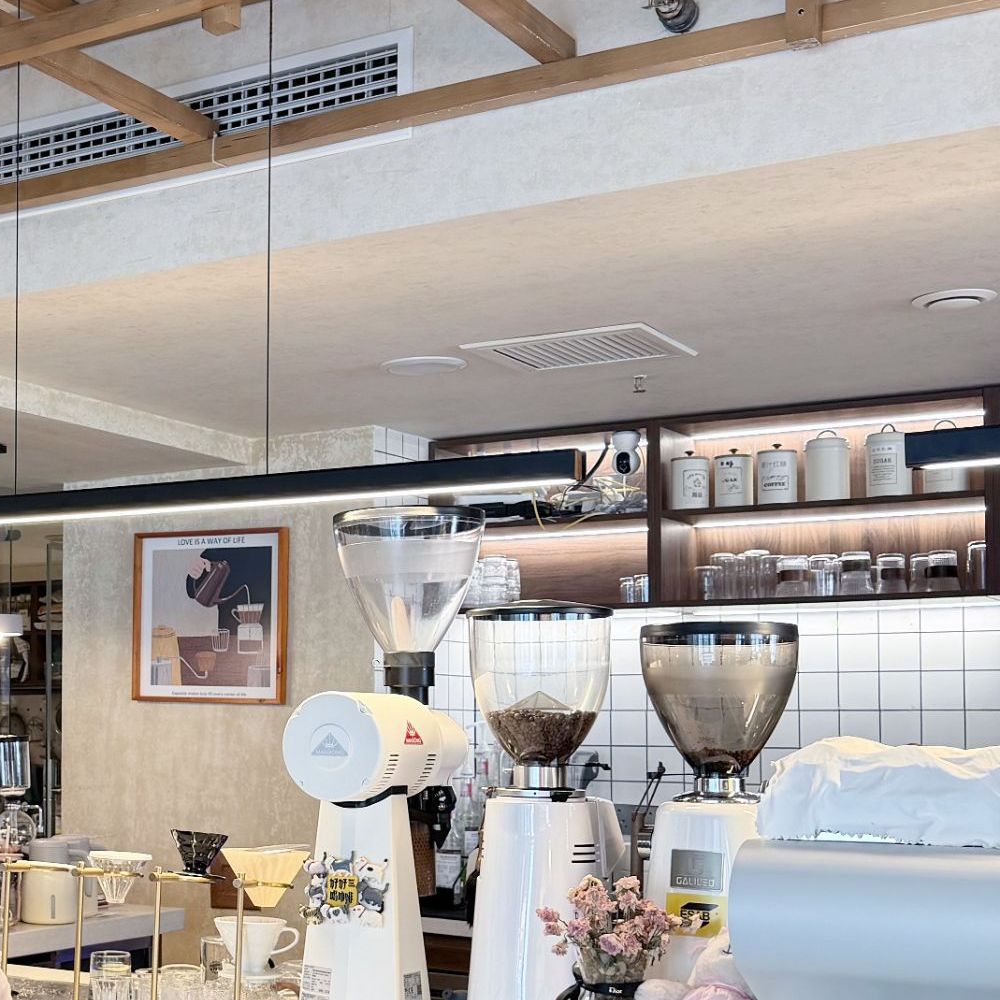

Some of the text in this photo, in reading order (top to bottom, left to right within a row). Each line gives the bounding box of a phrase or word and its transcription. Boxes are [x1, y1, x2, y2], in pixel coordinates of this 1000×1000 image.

[207, 537, 222, 545] WAY
[233, 536, 246, 544] LIFE
[676, 876, 716, 888] GALILEO
[608, 986, 623, 994] Dior
